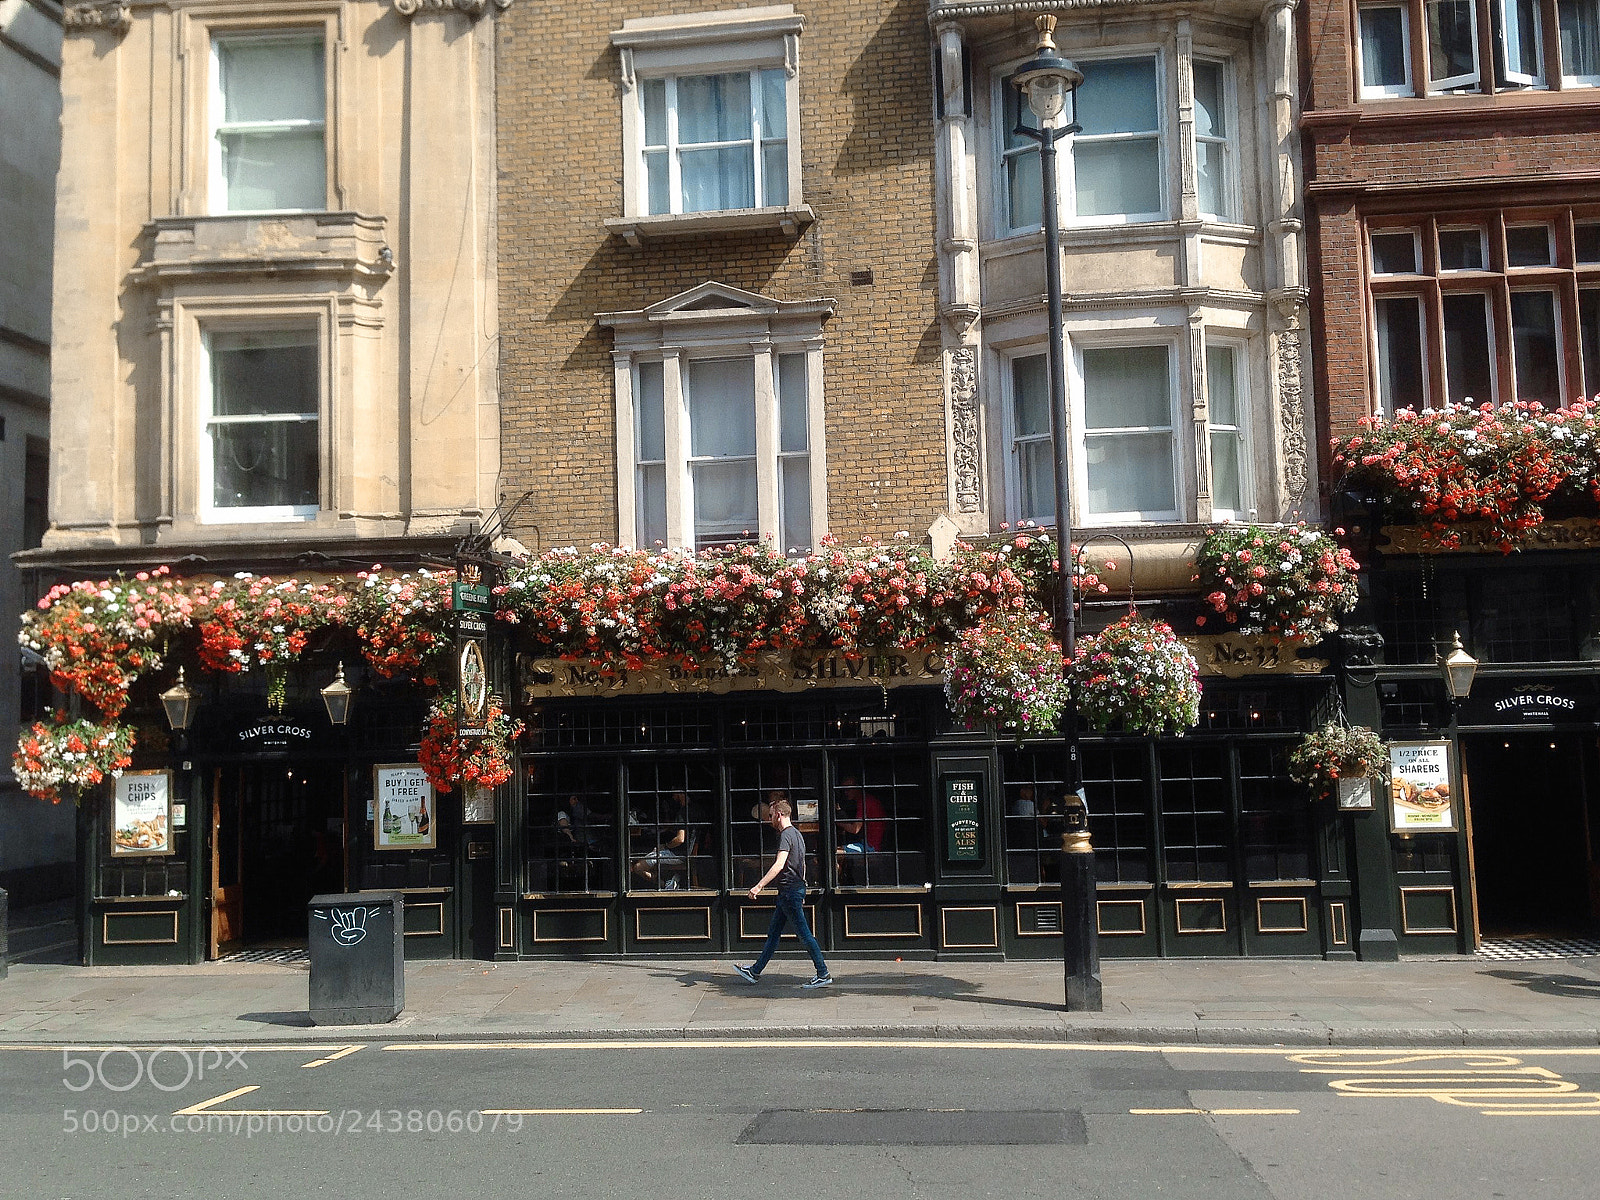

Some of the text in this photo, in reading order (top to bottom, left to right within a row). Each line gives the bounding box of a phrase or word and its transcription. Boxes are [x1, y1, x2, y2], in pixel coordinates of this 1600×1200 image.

[1494, 695, 1576, 711] SILVER CROSS
[239, 725, 312, 740] SILVER CROSS
[1412, 749, 1439, 757] PRICE
[1399, 764, 1440, 773] SHARERS
[385, 779, 402, 787] BUY
[409, 778, 425, 786] GET
[952, 783, 974, 791] FISH
[128, 783, 150, 792] FISH
[397, 787, 418, 796] FREE
[127, 792, 156, 802] CHIPS
[950, 795, 978, 803] CHIPS
